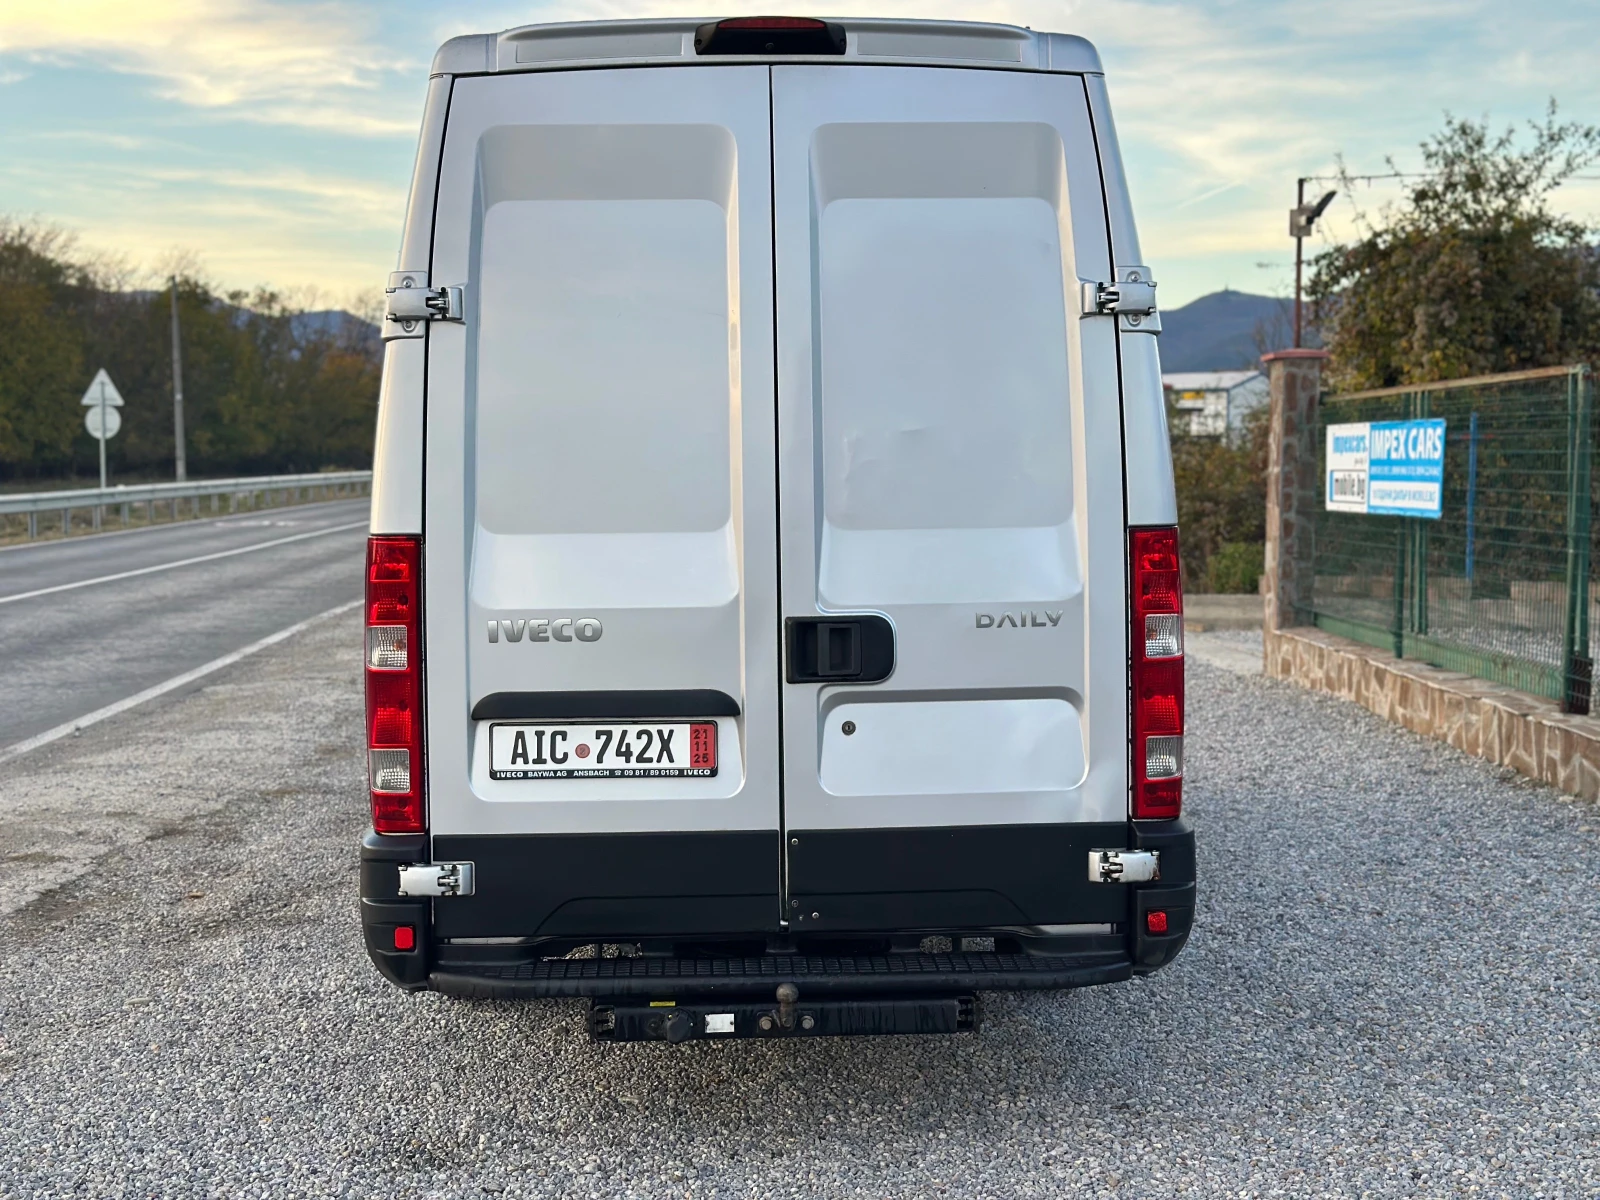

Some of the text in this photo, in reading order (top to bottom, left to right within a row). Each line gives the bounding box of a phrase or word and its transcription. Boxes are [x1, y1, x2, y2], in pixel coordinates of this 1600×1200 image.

[1371, 427, 1441, 460] IMPEX CARS
[975, 610, 1063, 628] DAILY
[487, 617, 603, 643] IVECO
[693, 728, 708, 740] 21
[510, 728, 675, 765] AIC 742X
[694, 740, 708, 752] 11
[684, 768, 711, 776] IVECO
